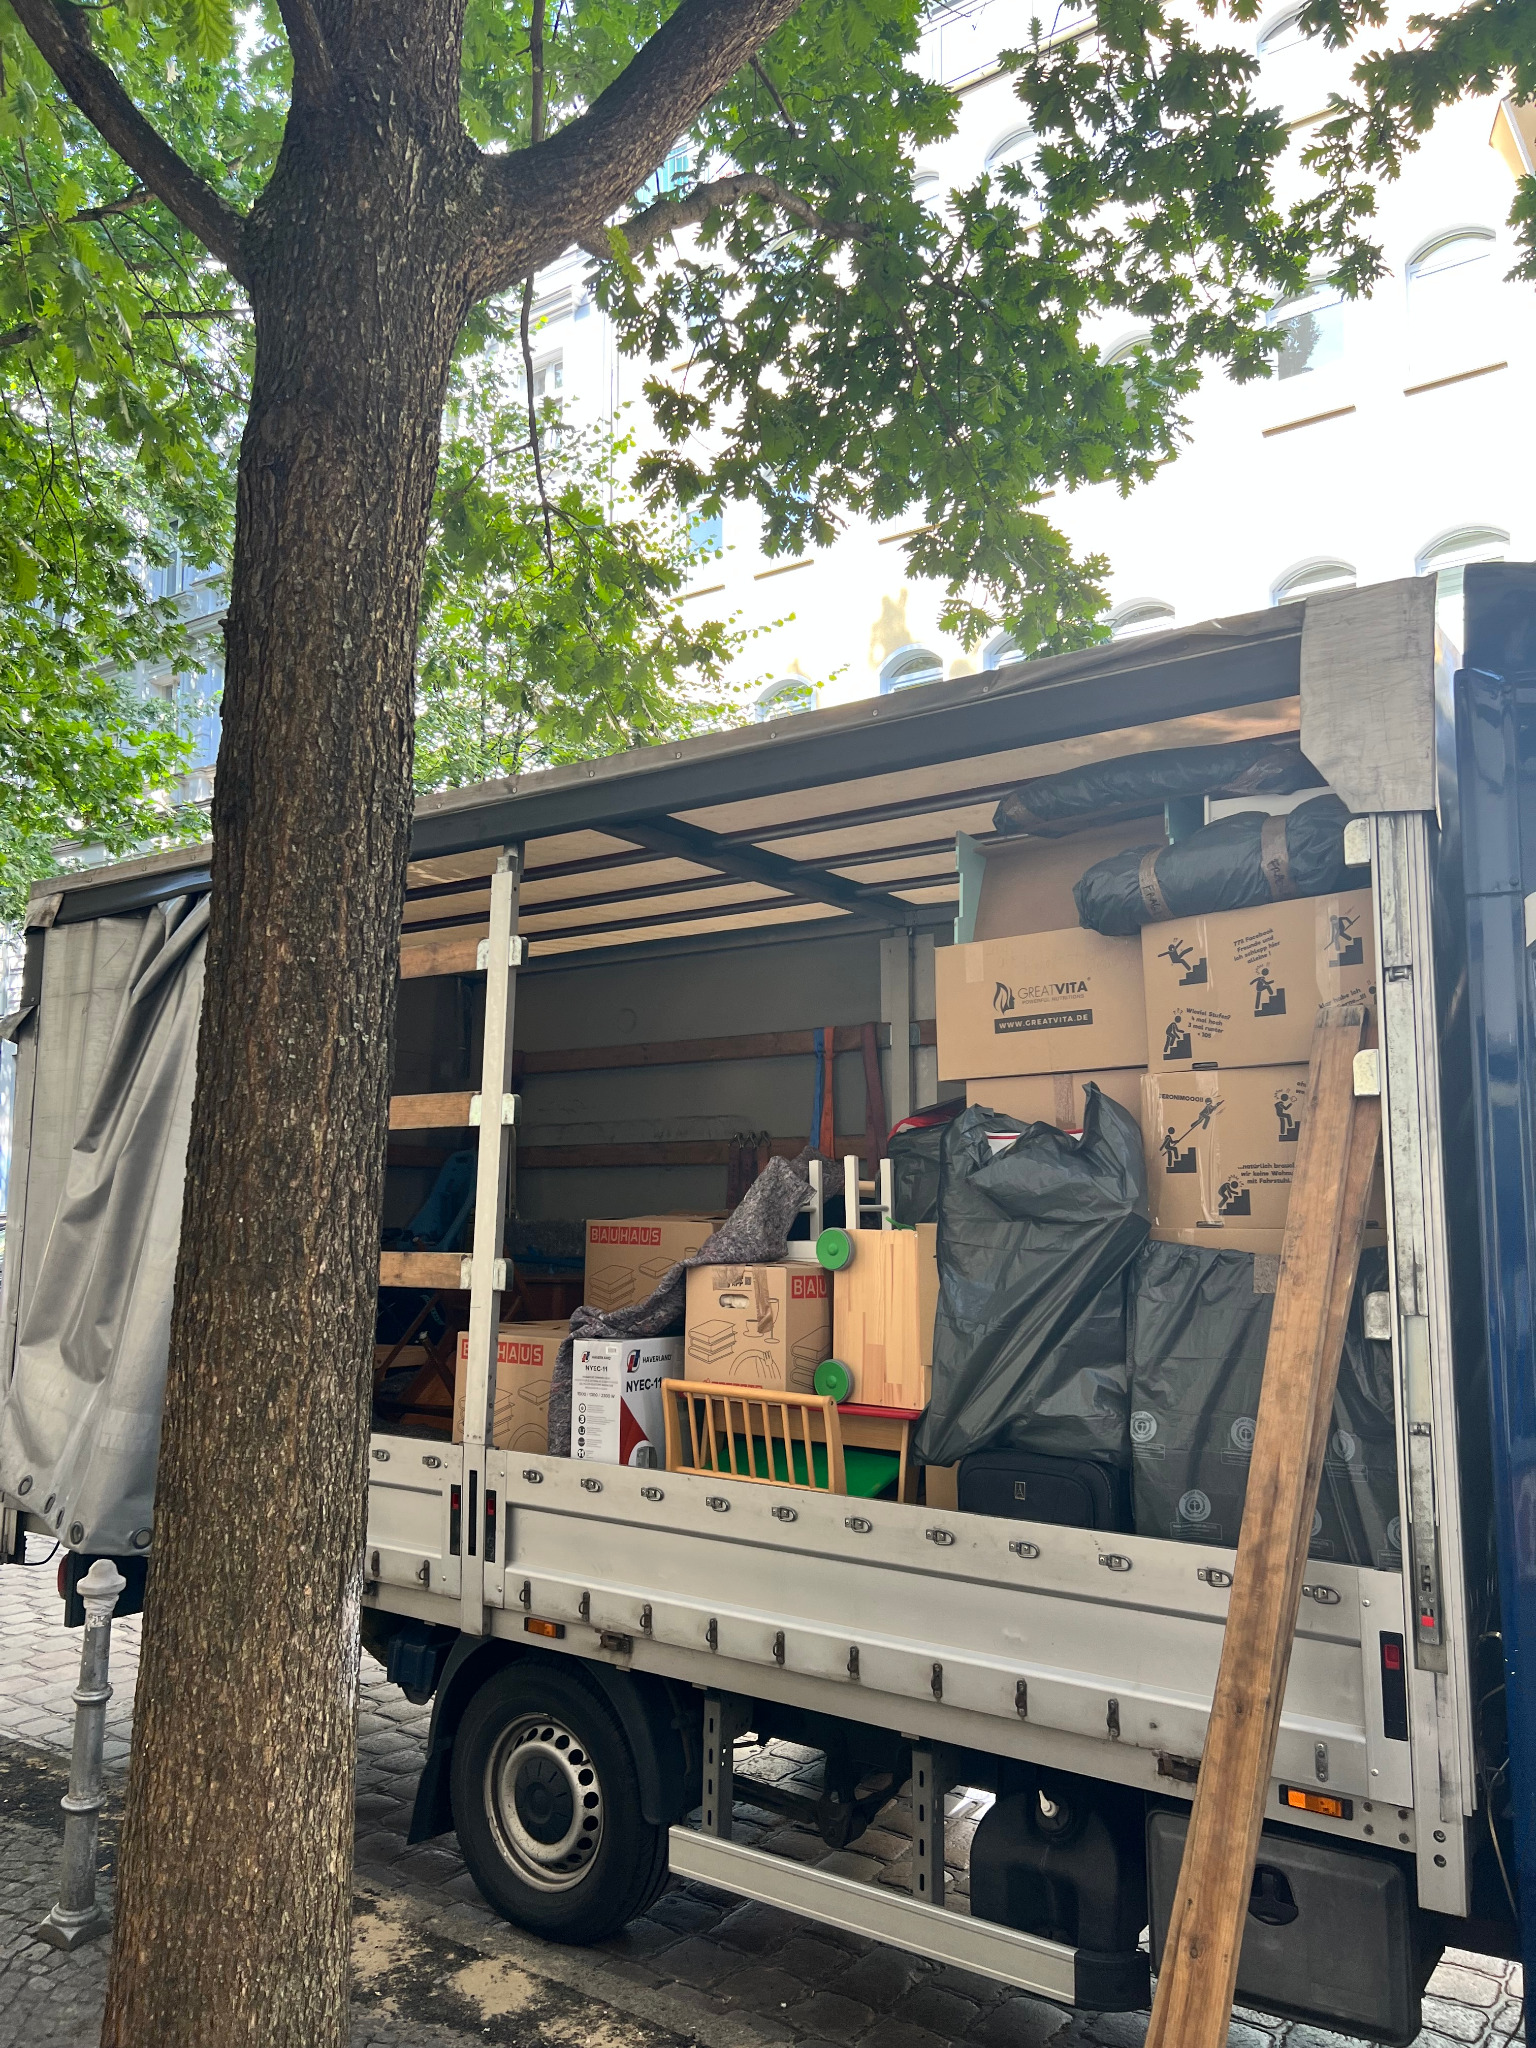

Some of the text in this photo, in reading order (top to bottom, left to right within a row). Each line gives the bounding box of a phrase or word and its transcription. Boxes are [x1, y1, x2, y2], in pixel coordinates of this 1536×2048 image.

[1245, 928, 1274, 942] Facebook
[1237, 935, 1274, 952] Freunde und
[1244, 946, 1267, 957] schlepp
[1268, 941, 1280, 949] hier
[1247, 953, 1268, 963] alleine
[1018, 981, 1088, 999] GREATVITA
[1333, 993, 1350, 1003] habe
[998, 1013, 1089, 1029] WWW.GREATVITA.DE
[1186, 1008, 1231, 1020] Wieviel Stufen?
[590, 1227, 661, 1245] BAUHAUS
[462, 1340, 543, 1364] BHAUS
[642, 1354, 672, 1363] HAVERLAND
[626, 1376, 662, 1392] NYEC-11
